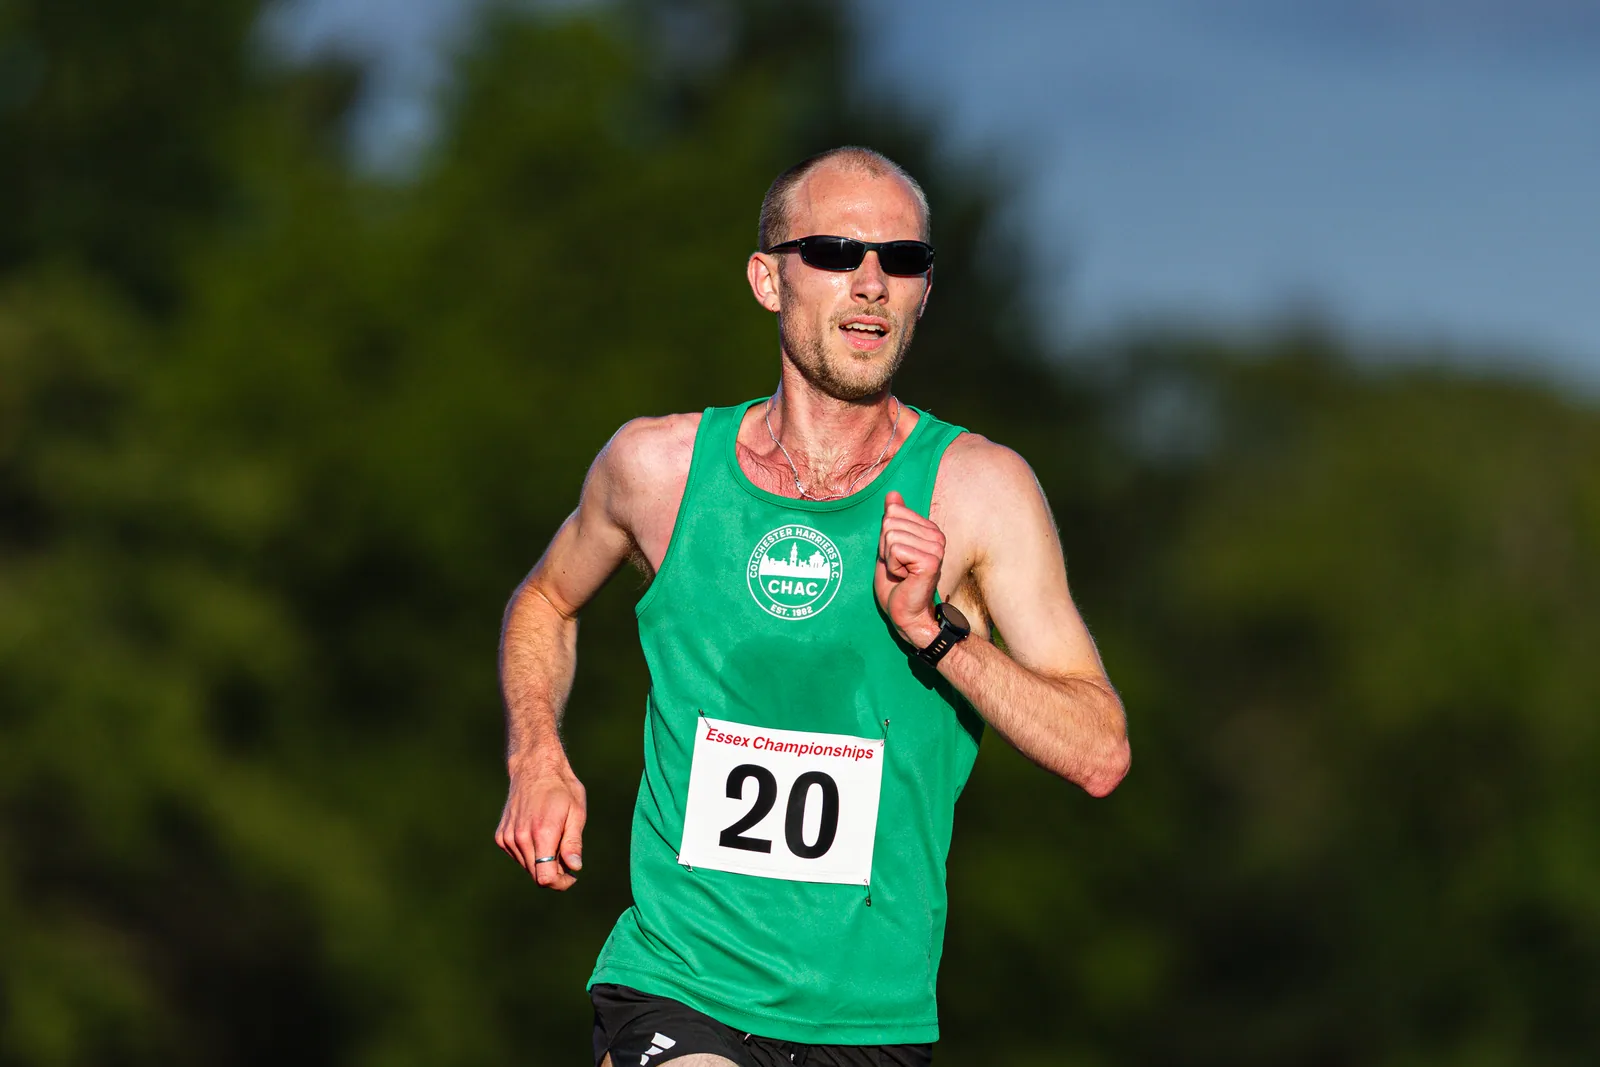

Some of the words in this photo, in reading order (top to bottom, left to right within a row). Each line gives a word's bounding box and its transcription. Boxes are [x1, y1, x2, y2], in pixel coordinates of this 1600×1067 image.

[750, 528, 792, 578] COLCHESTER
[796, 528, 836, 560] HARRIERS
[768, 580, 818, 596] CHAC
[770, 604, 790, 616] EST.
[706, 728, 750, 748] Essex
[753, 736, 874, 761] Championships
[719, 763, 839, 860] 20
